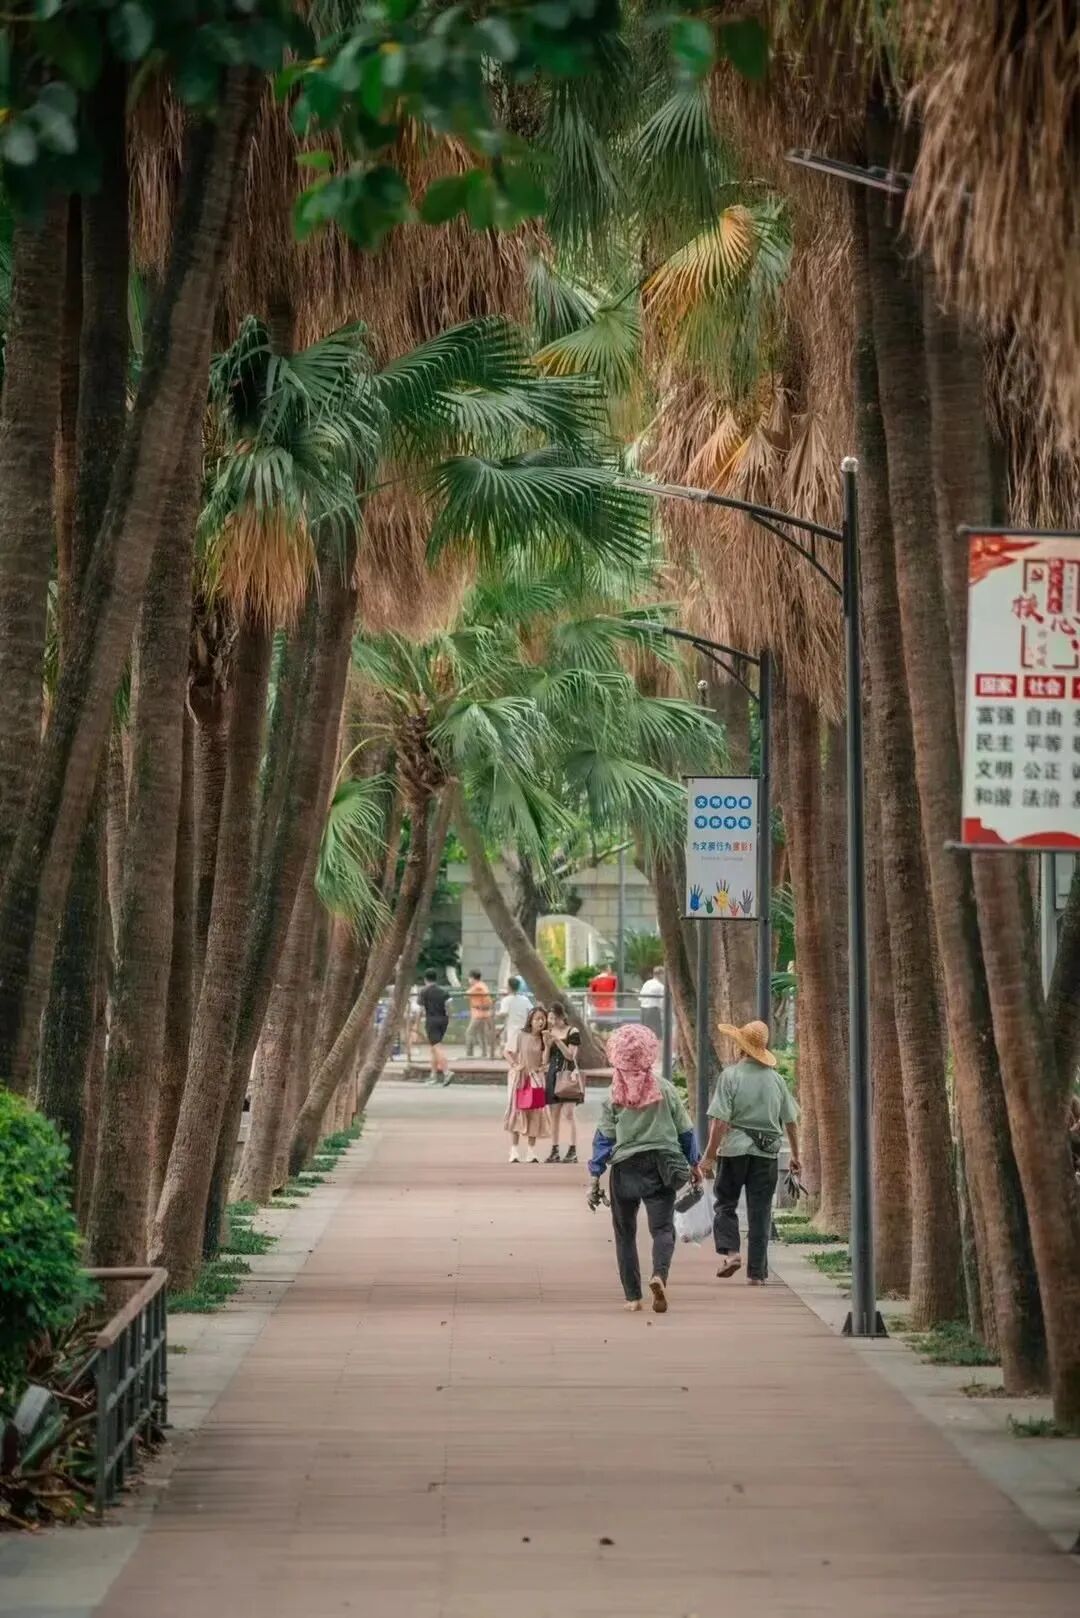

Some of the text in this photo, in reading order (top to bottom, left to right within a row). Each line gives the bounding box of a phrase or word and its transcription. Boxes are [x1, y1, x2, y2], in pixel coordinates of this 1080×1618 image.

[979, 676, 1014, 695] 国家
[1028, 677, 1062, 696] 社会
[977, 707, 1014, 725] 富强
[1026, 708, 1061, 727] 自由
[976, 733, 1014, 752] 民主
[1025, 734, 1062, 753] 平等
[976, 761, 1013, 779] 文明
[1024, 762, 1060, 780] 公正
[975, 787, 1012, 806] 和谐
[1022, 788, 1060, 808] 法治
